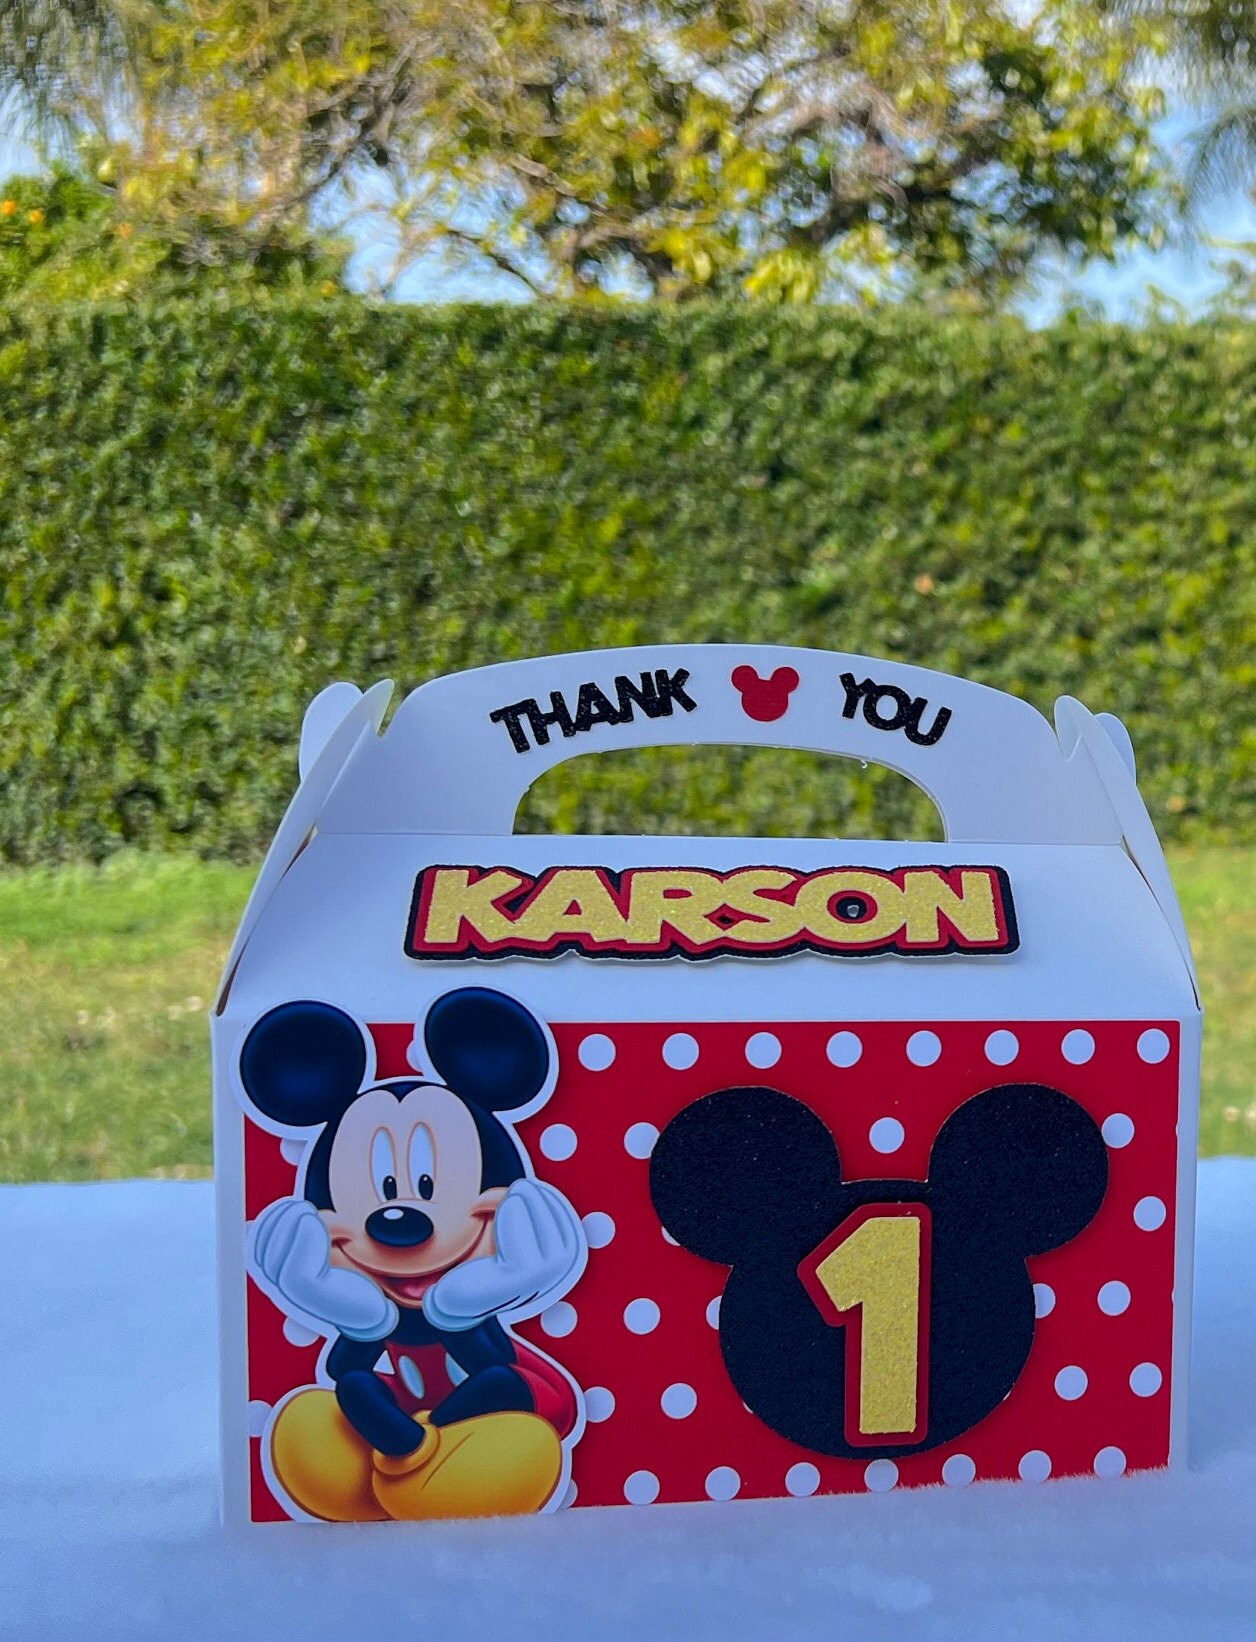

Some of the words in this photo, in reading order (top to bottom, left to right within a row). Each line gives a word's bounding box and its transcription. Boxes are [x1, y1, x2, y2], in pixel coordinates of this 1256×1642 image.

[490, 668, 698, 754] THANK
[839, 671, 953, 746] YOU
[425, 867, 996, 944] KARSON
[815, 1216, 922, 1434] 1
